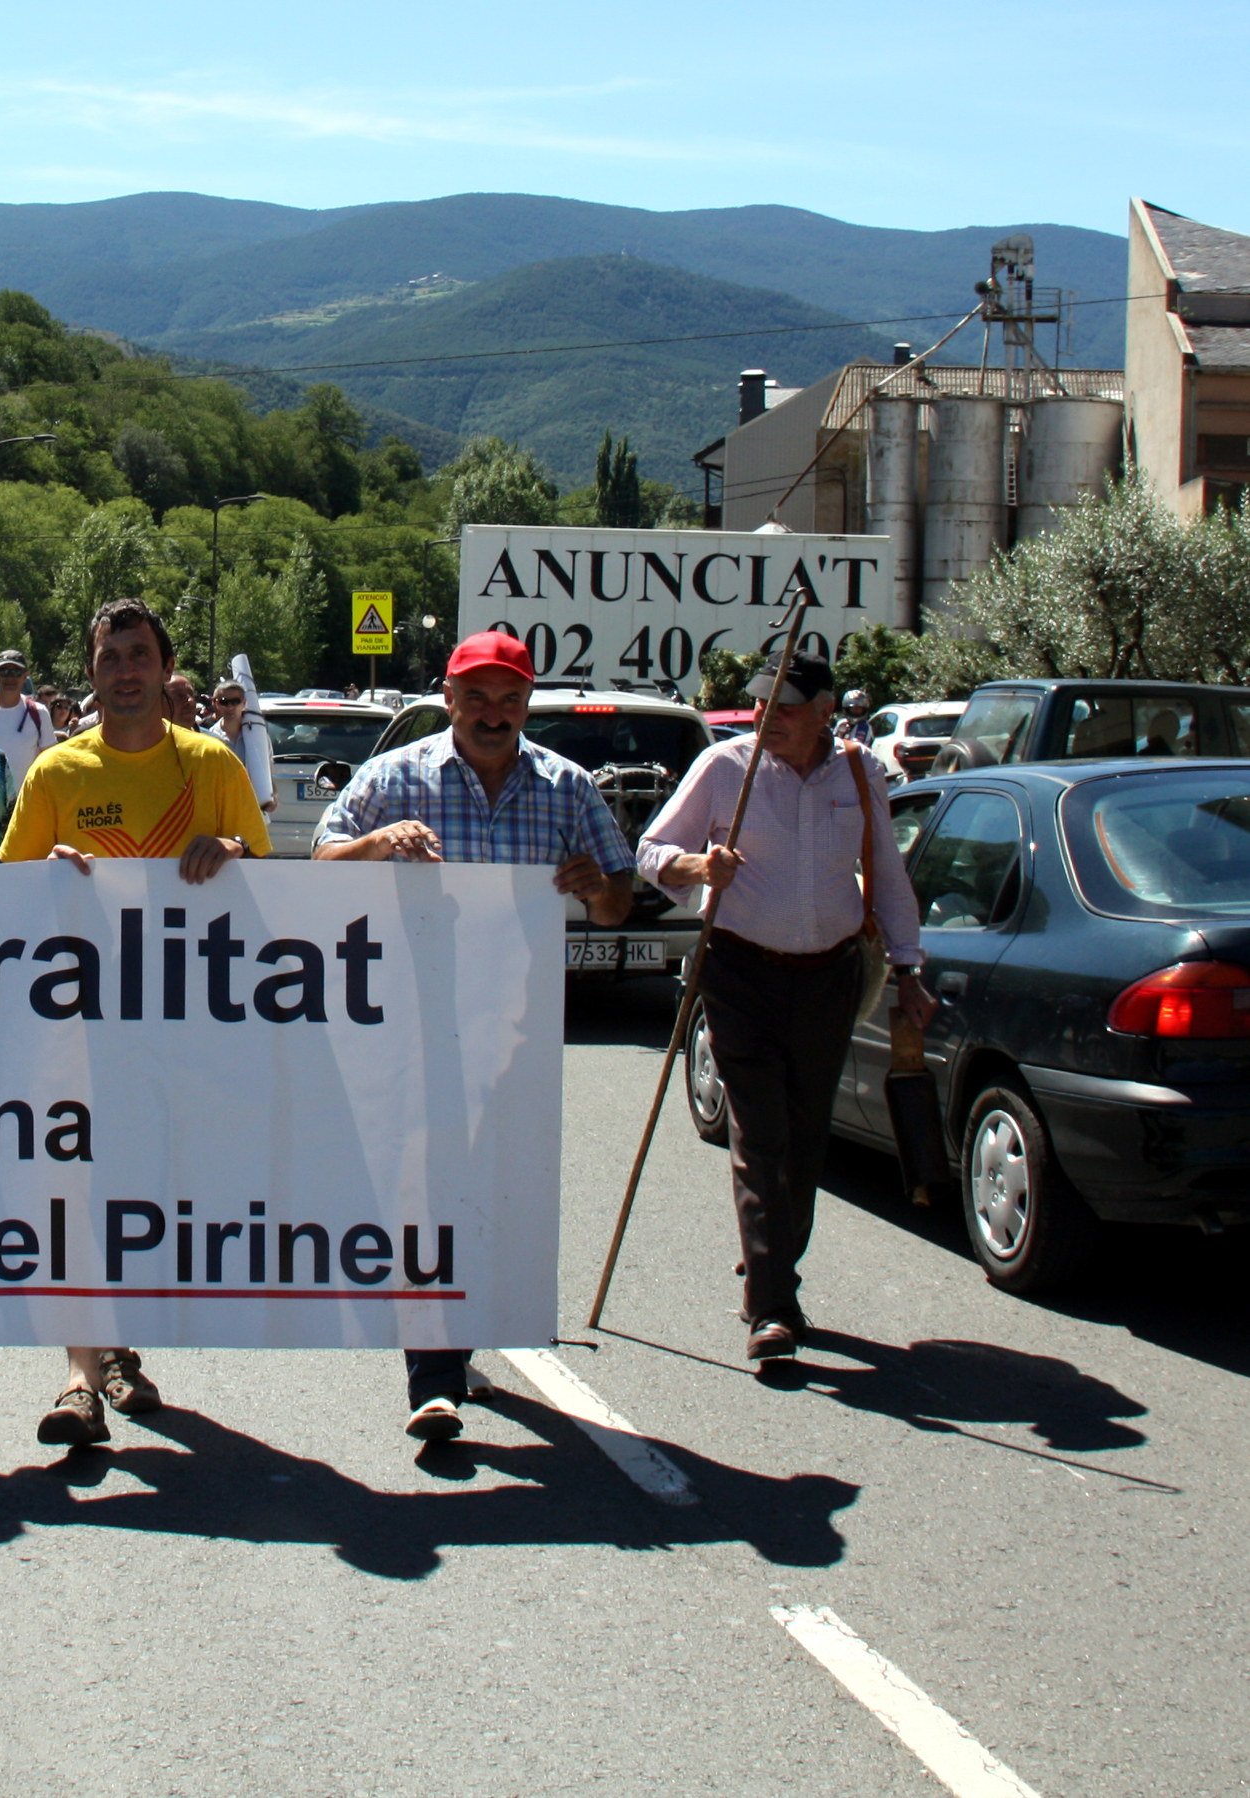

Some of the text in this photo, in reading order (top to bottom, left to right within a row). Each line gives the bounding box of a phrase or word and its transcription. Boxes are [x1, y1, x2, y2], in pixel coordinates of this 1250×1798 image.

[478, 547, 878, 609] ANUNCIA'T
[78, 801, 123, 818] ARA ÉS
[78, 815, 123, 829] L'HORA
[571, 943, 659, 962] 7532 HKL
[105, 1199, 454, 1287] Pirineu
